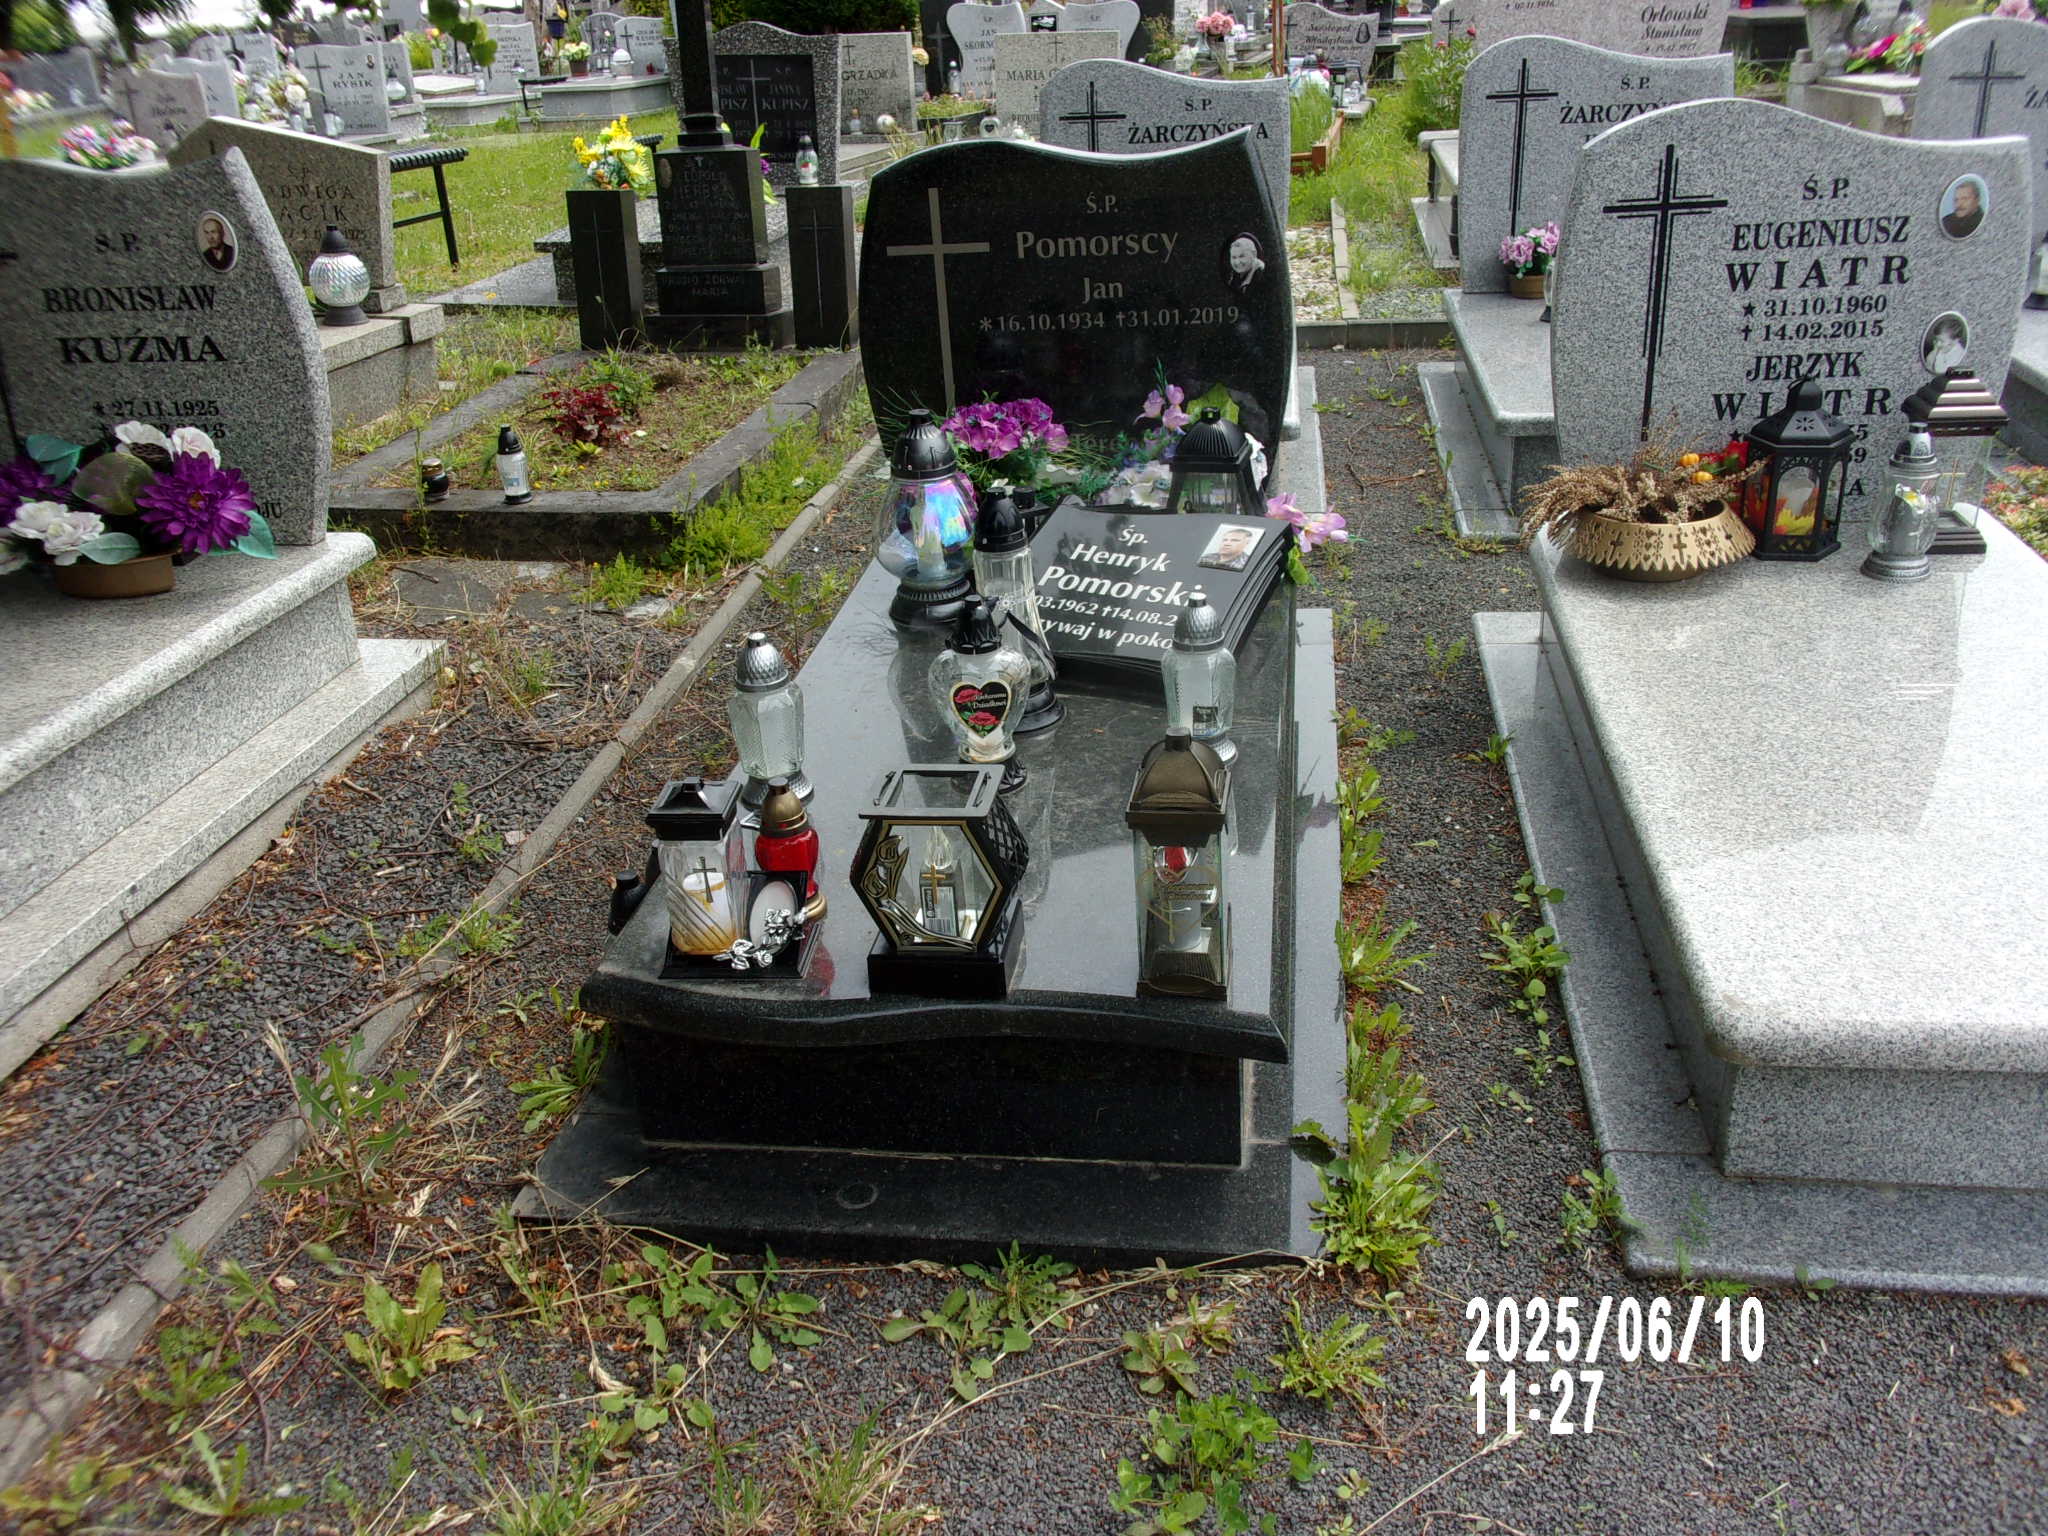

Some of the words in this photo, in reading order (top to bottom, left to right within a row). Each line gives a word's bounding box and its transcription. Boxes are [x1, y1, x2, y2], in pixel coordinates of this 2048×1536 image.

[1006, 69, 1045, 81] MARIA
[1016, 231, 1179, 264] Pomorscy
[1731, 215, 1912, 252] EUGENIUSZ
[41, 284, 217, 314] BRONISŁAW
[1082, 276, 1124, 304] Jan
[1764, 294, 1888, 318] 31.10.1960
[1762, 319, 1885, 343] 14.02.2015
[55, 328, 229, 365] KUŹMA
[1746, 351, 1864, 382] JERZYK
[1711, 387, 1893, 421] WITR
[1117, 524, 1149, 545] Śp.
[1070, 542, 1171, 576] Henryk
[1098, 628, 1117, 641] w
[1117, 630, 1174, 651] poko
